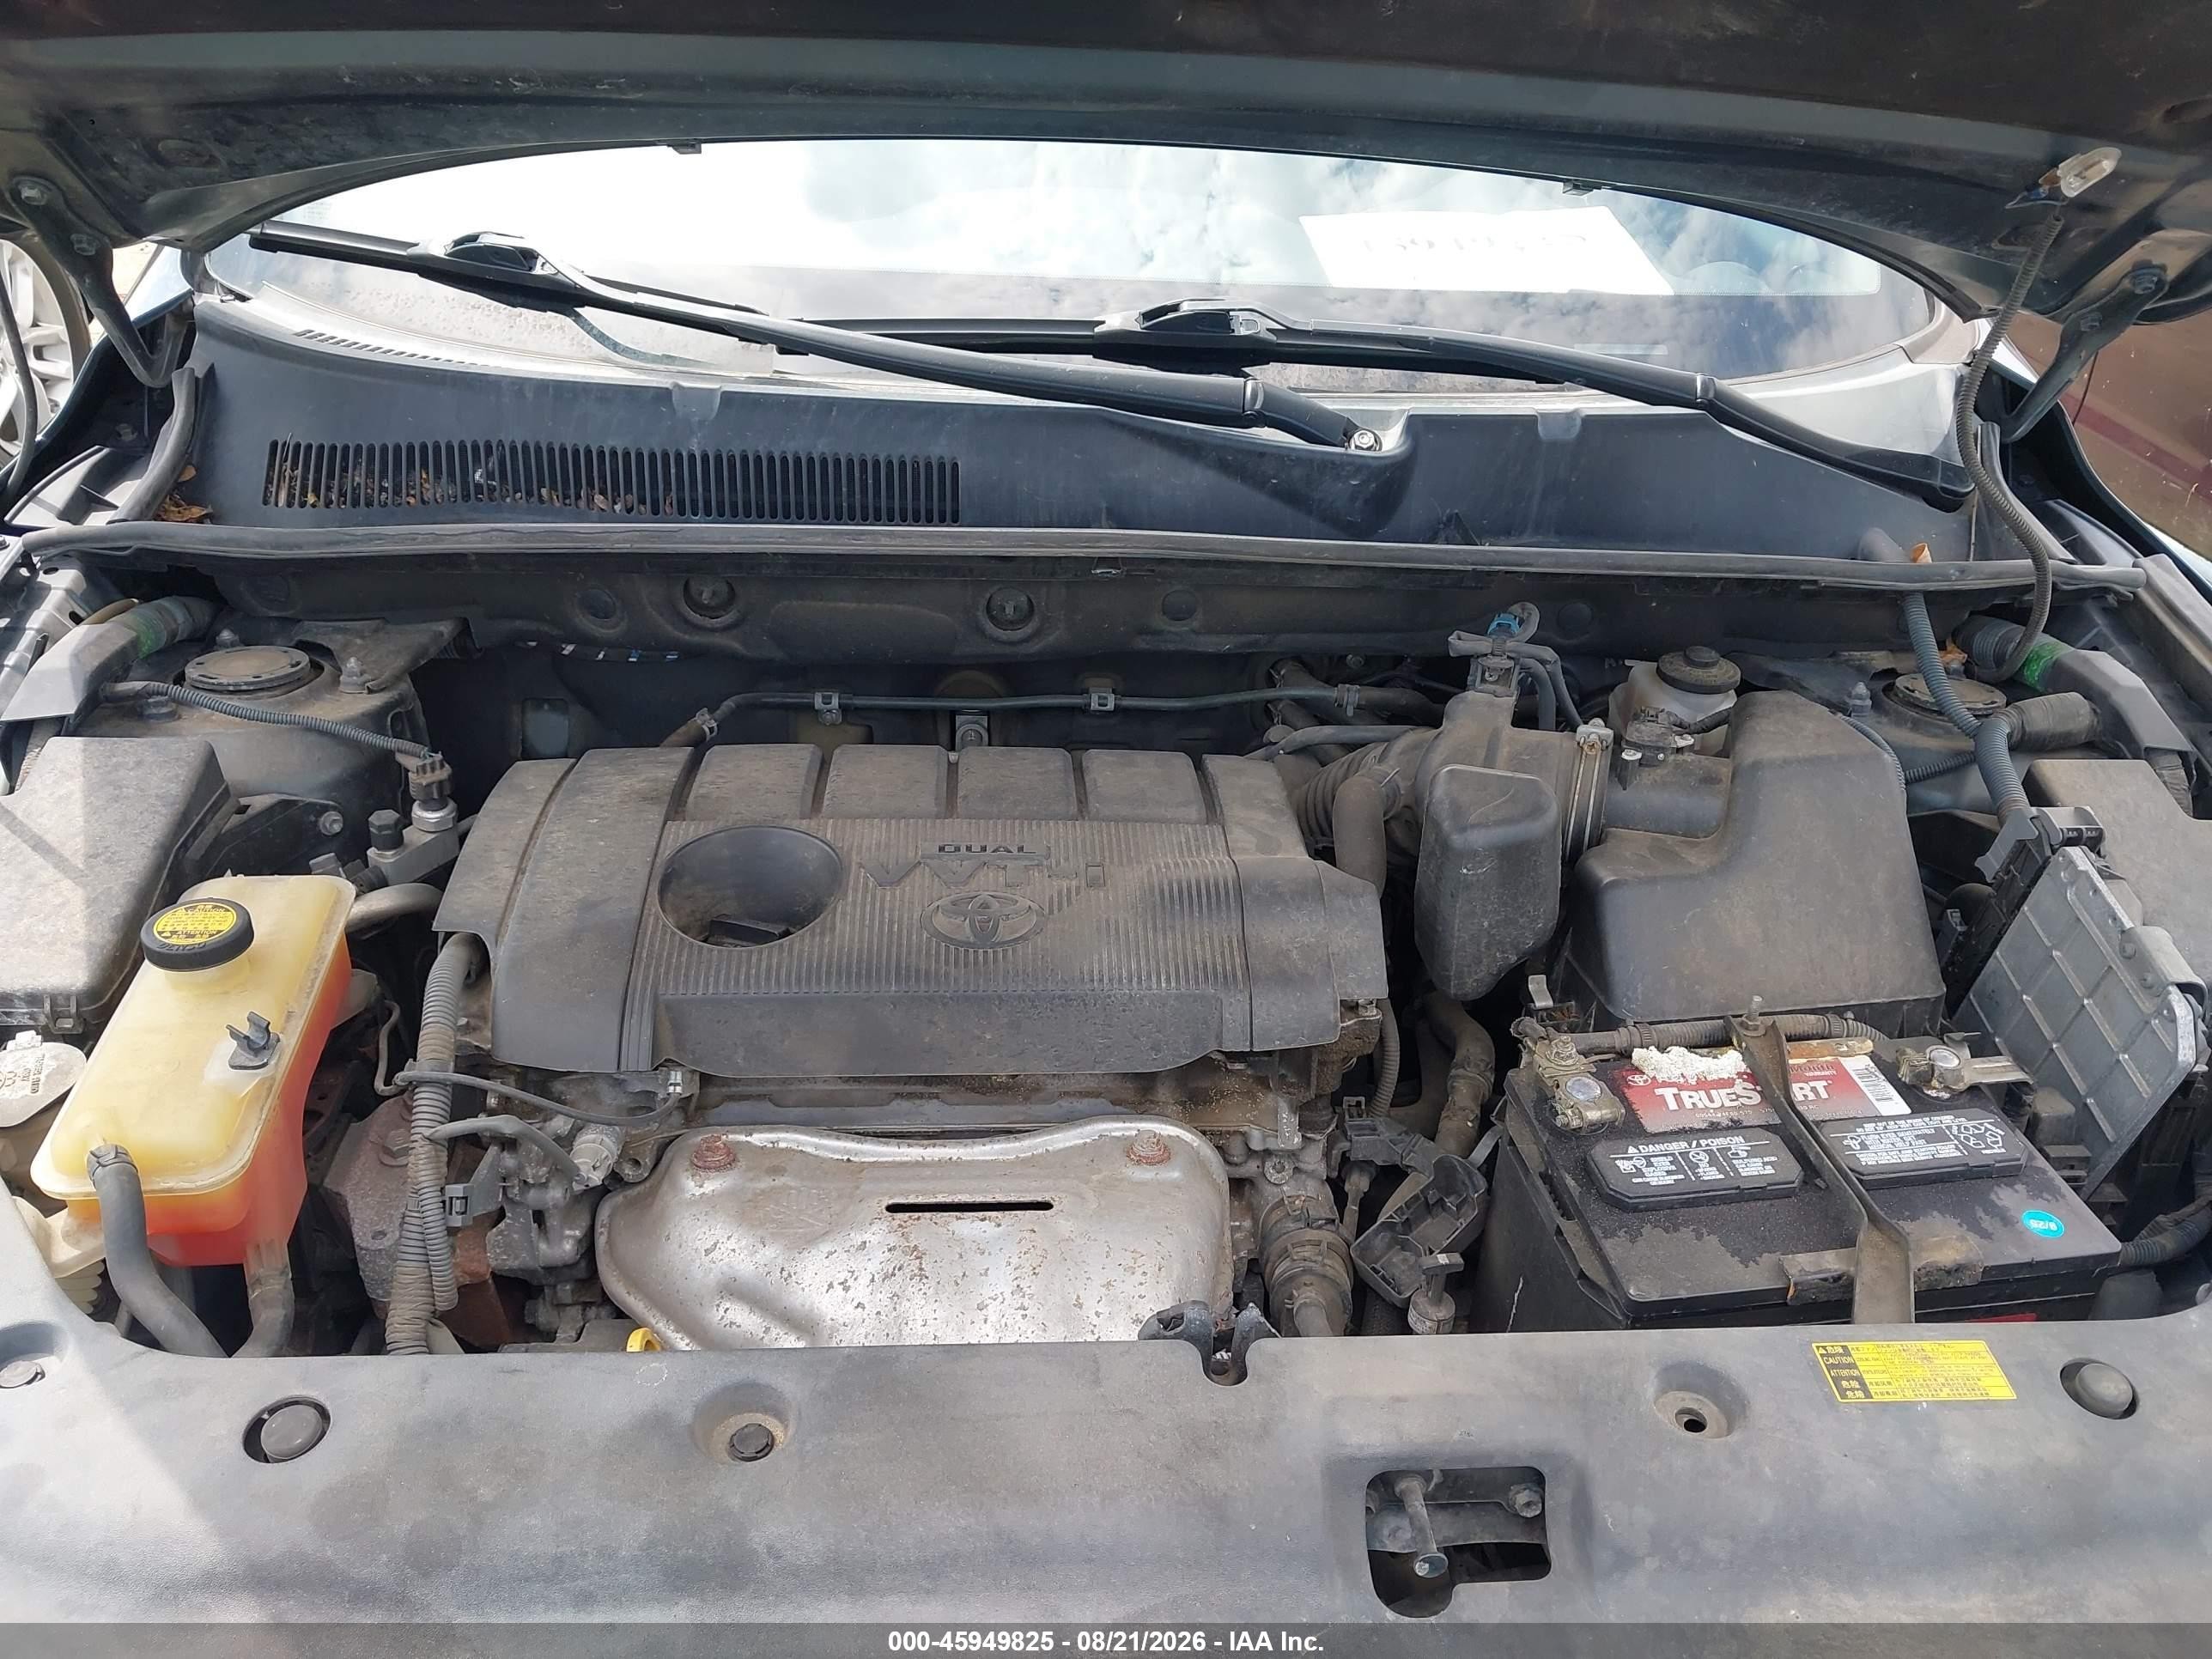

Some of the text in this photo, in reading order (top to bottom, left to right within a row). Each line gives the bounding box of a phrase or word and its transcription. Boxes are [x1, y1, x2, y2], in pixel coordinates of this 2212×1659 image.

[938, 844, 1036, 854] DUAL
[1655, 1079, 1829, 1111] TRUESRT
[1638, 1140, 1690, 1153] DANGER
[1699, 1136, 1746, 1146] POISON
